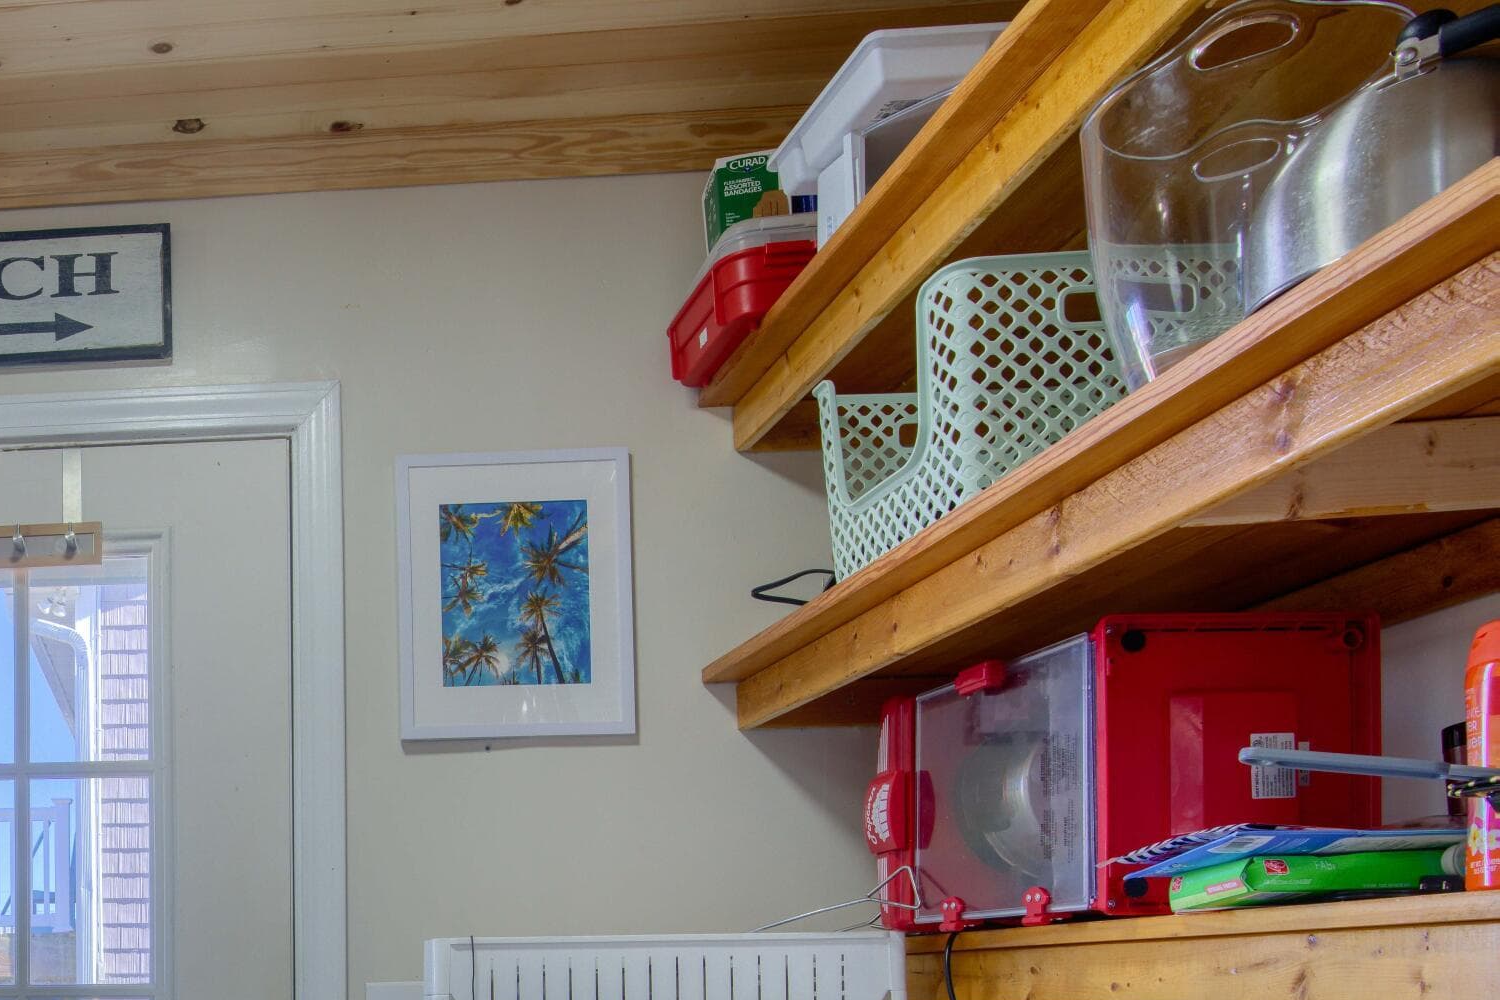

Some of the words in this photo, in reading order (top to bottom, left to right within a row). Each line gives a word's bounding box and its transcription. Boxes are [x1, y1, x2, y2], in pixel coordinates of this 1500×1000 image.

[729, 156, 766, 170] CURAD
[724, 180, 761, 191] ASSORTED
[724, 186, 762, 197] BANDAGES
